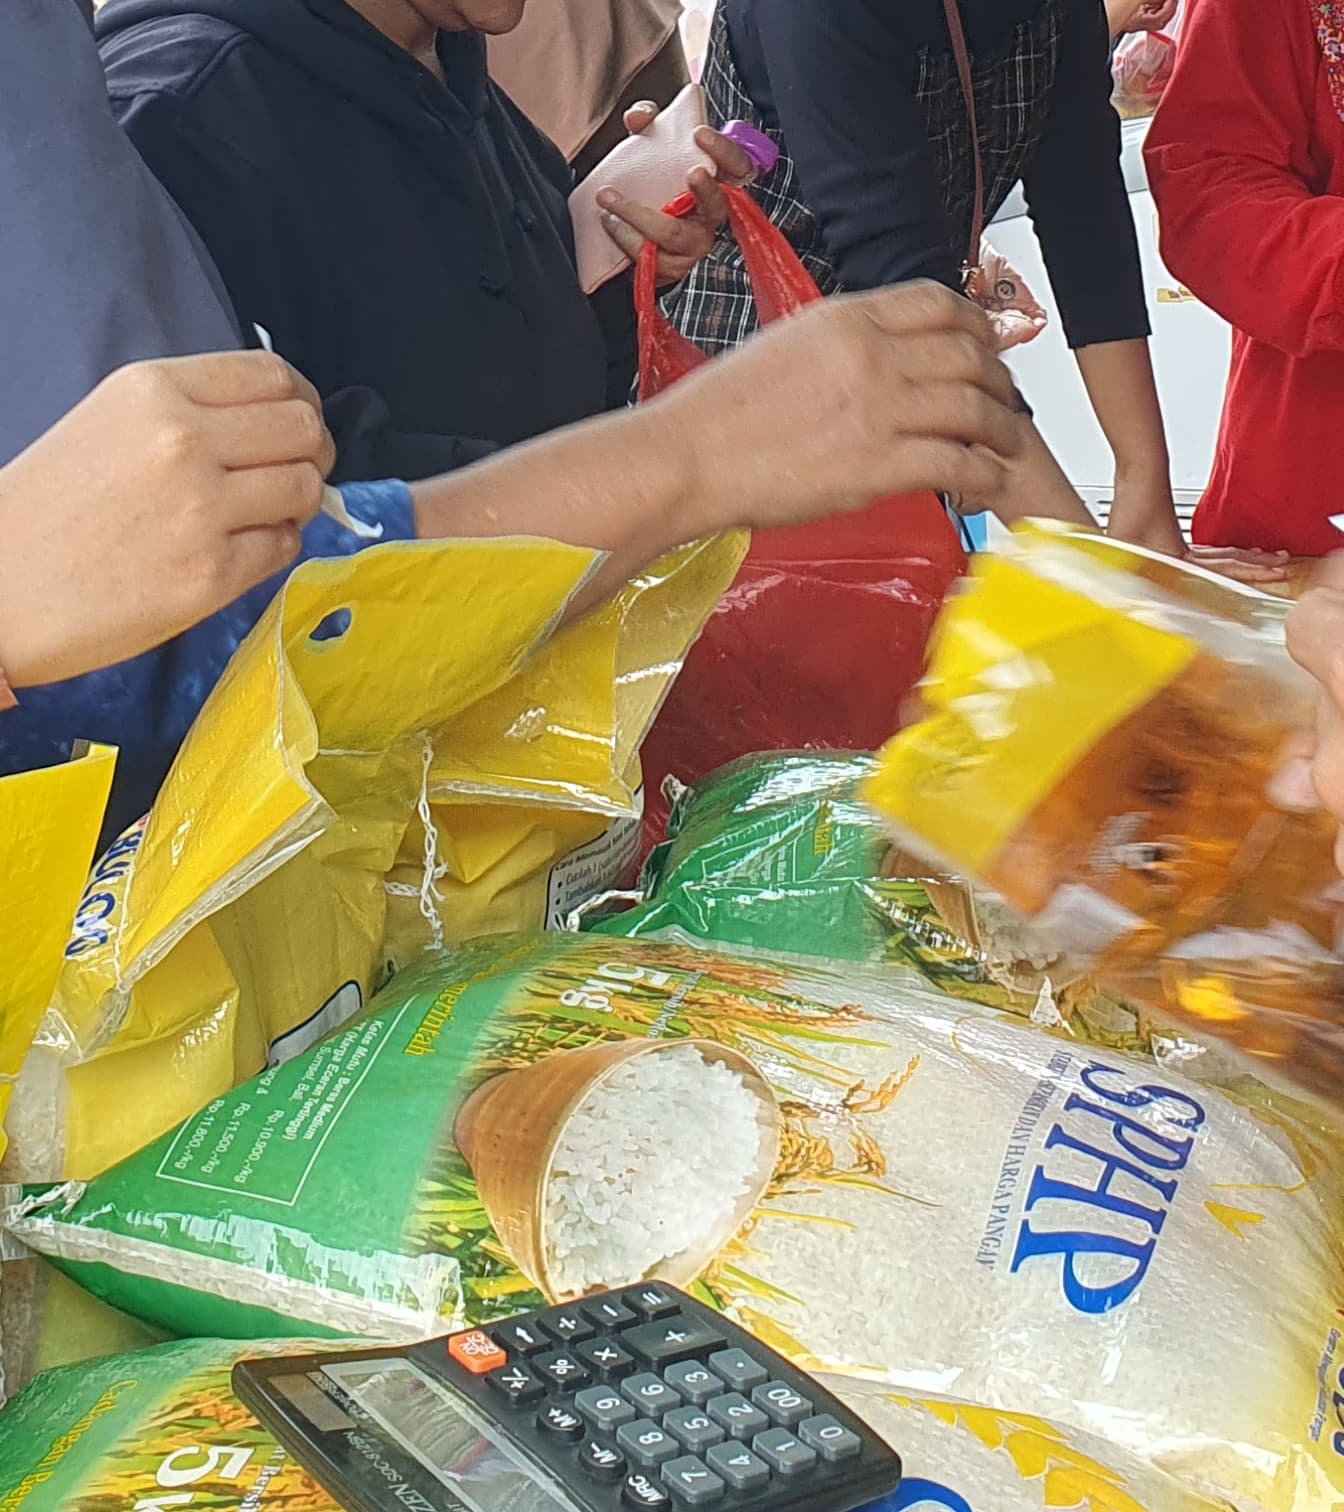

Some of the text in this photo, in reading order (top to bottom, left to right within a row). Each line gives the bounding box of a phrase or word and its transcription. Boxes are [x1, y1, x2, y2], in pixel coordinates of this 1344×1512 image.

[328, 1029, 358, 1065] (Harga
[359, 1017, 384, 1048] Kelas
[345, 1045, 367, 1072] Mutu
[309, 1060, 340, 1099] Eceran
[324, 1073, 349, 1105] Beras
[279, 1093, 318, 1144] Tertinggi)
[301, 1101, 333, 1143] Medium
[1010, 1115, 1036, 1144] DAN
[989, 1140, 1027, 1207] HARGA
[1010, 1061, 1205, 1315] SPHP
[686, 1371, 709, 1384] 3
[728, 1403, 754, 1418] 2
[767, 1389, 802, 1410] 00
[684, 1417, 709, 1431] 5
[819, 1426, 844, 1441] 0
[639, 1432, 664, 1446] 8
[156, 1445, 256, 1487] 5
[727, 1453, 753, 1468] 4
[628, 1475, 666, 1503] MRC
